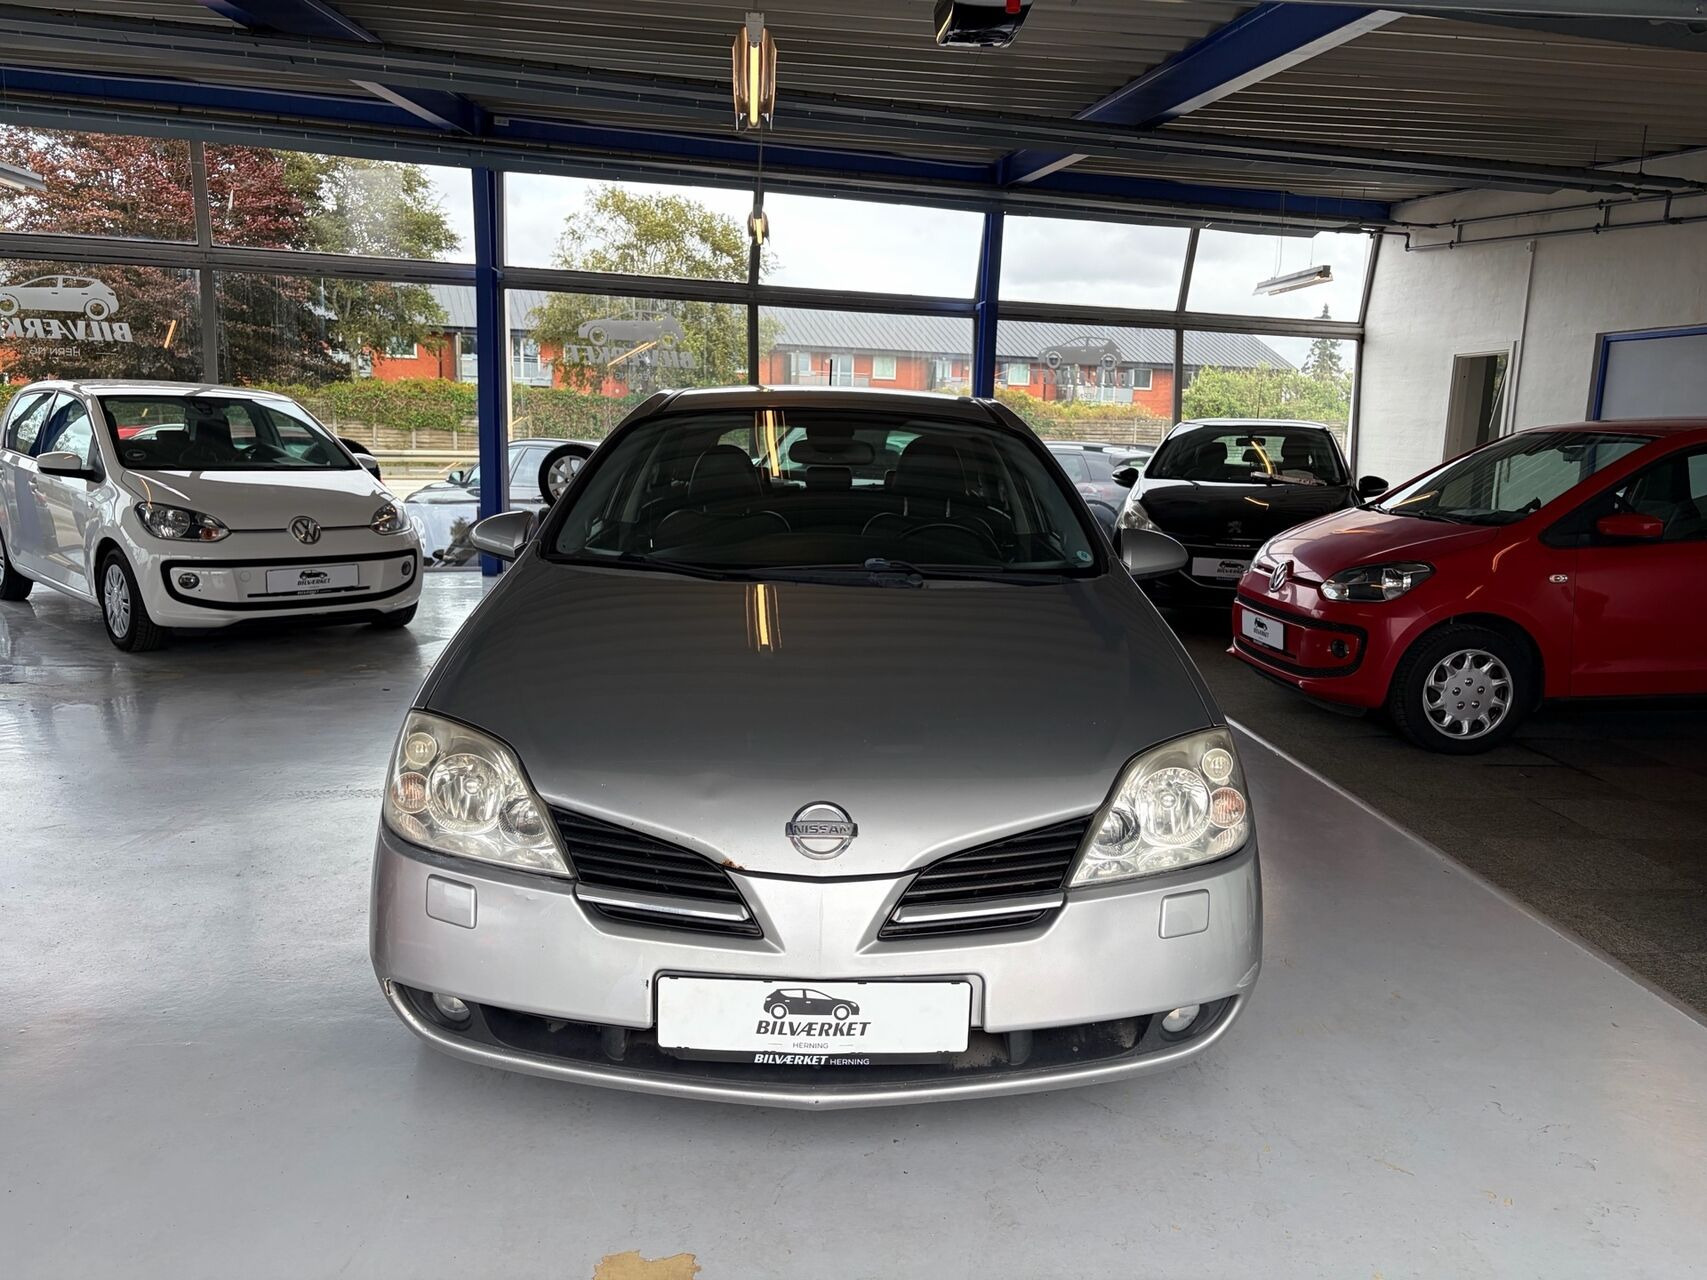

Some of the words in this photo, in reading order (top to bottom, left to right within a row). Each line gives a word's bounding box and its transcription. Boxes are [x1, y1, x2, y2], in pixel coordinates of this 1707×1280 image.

[793, 824, 850, 834] NISSAN
[756, 1020, 871, 1037] BILVÆRKET
[754, 1053, 829, 1066] BILVÆRKET
[829, 1058, 870, 1066] HERNING
